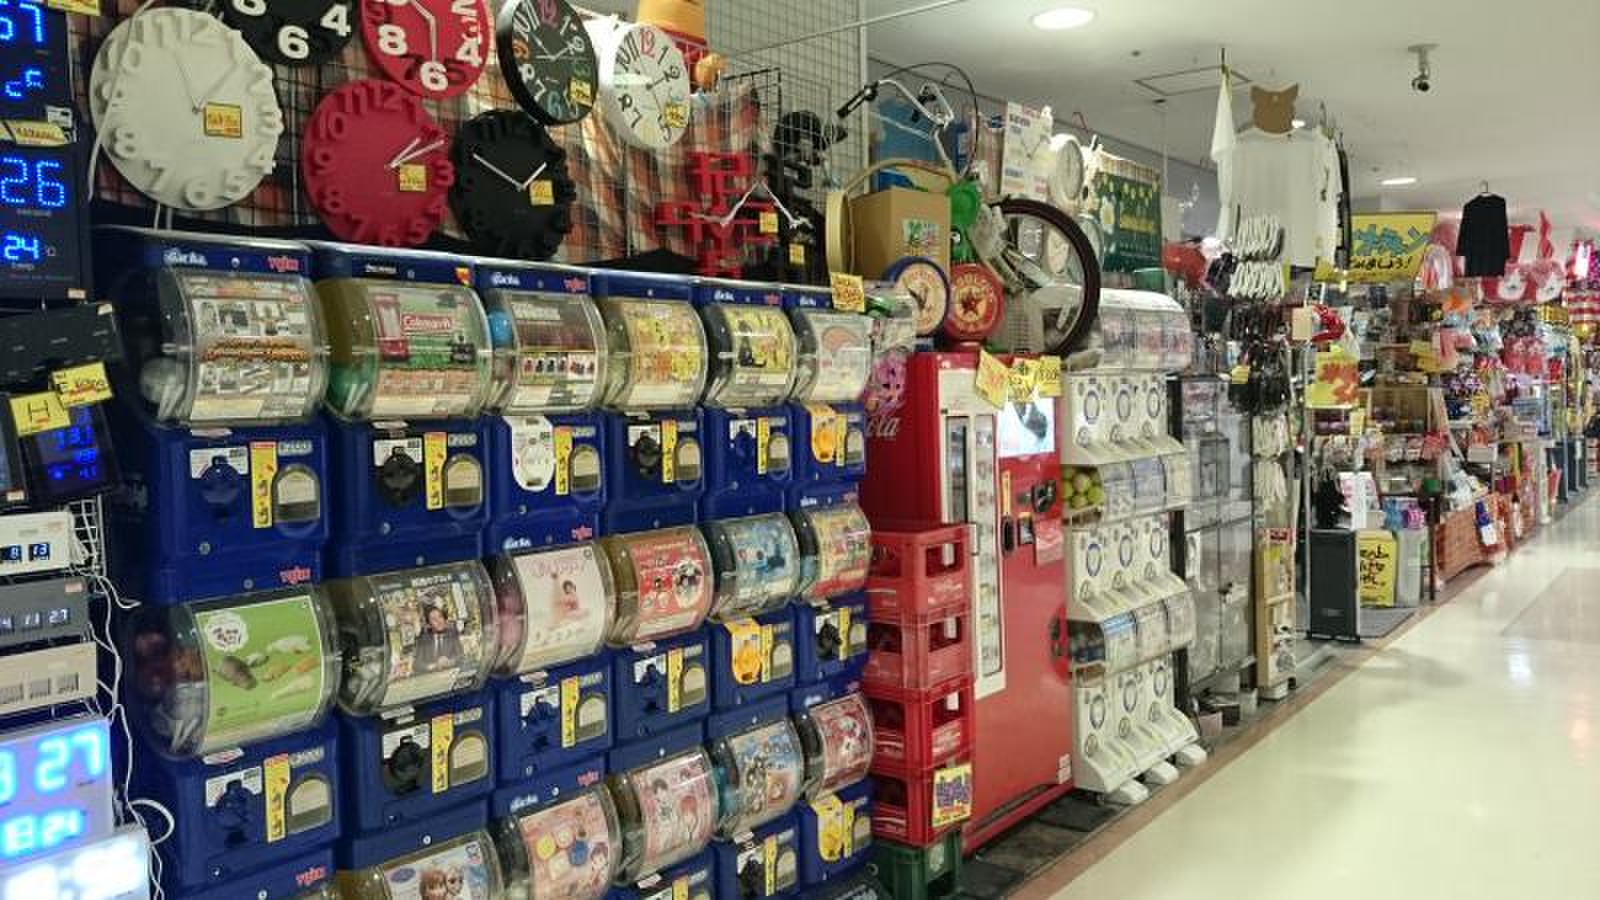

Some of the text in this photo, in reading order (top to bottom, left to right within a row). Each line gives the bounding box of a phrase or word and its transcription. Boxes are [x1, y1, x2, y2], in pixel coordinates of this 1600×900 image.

[321, 5, 350, 36] 4
[278, 26, 309, 59] 6
[378, 24, 408, 55] 8
[456, 34, 484, 67] 4
[421, 61, 448, 91] 6
[0, 155, 65, 207] 26
[4, 234, 40, 260] 24
[49, 608, 69, 625] 27
[36, 729, 105, 793] 27
